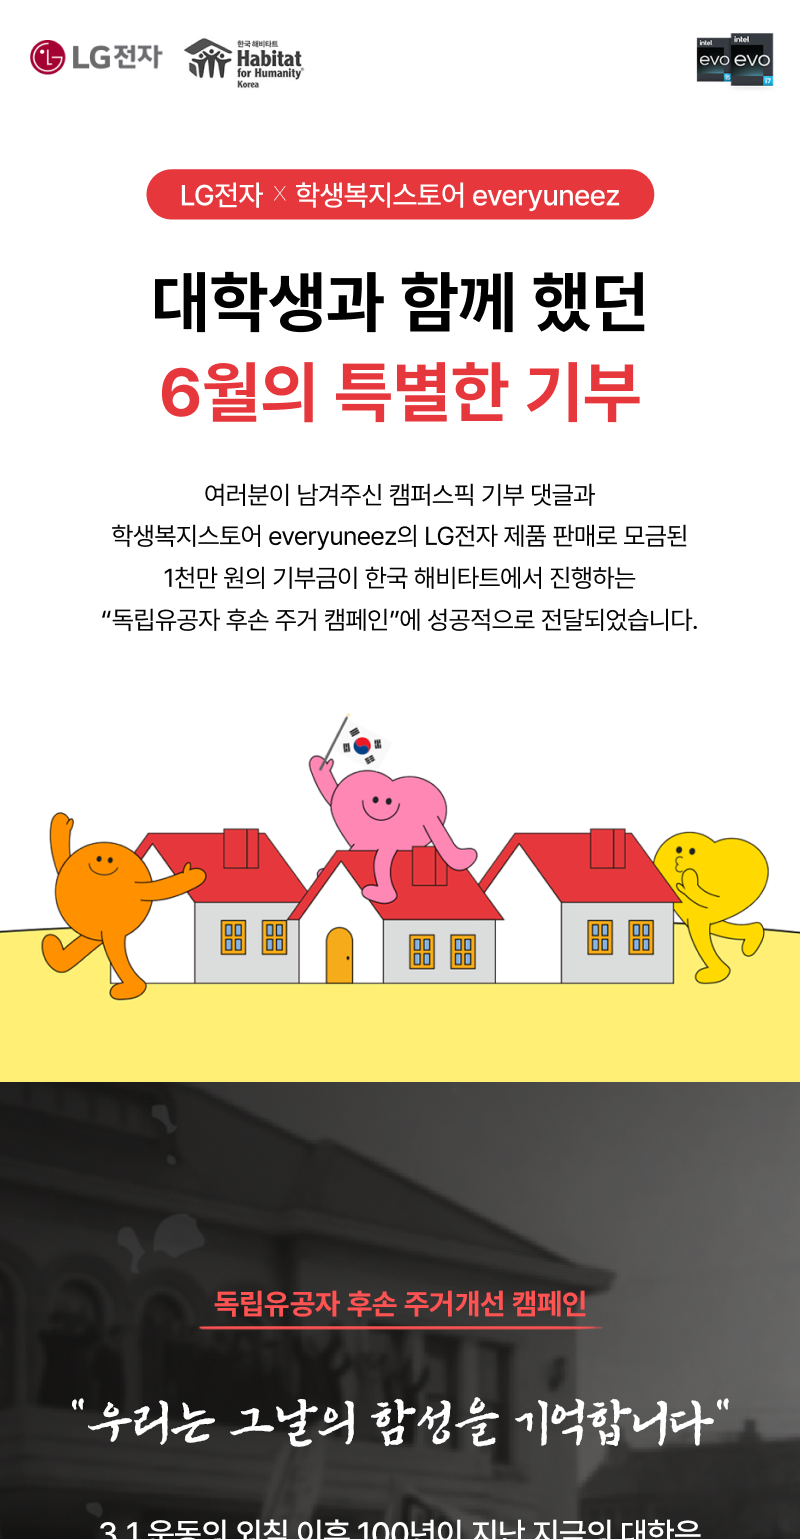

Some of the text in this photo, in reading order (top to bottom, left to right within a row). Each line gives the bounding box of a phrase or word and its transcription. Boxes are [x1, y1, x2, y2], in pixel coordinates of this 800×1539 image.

[73, 45, 163, 69] LG전자
[237, 50, 302, 67] Habitat
[699, 55, 731, 66] evo
[734, 54, 771, 67] evo
[237, 68, 302, 80] for Humanity
[237, 81, 260, 89] Korea
[182, 182, 263, 208] LG전자
[296, 182, 463, 208] 학생복지스토어
[473, 190, 619, 211] everyuneez
[155, 272, 644, 332] 대학생과 함께 했던
[162, 362, 640, 422] 6월의 특별한 기부
[205, 483, 595, 506] 여러분이 남겨주신 캠퍼스픽 기부 댓글과
[226, 608, 269, 631] 후손
[275, 609, 316, 631] 주거
[428, 609, 535, 631] 성공적으로
[542, 609, 697, 631] 전달되었습니다.
[215, 1291, 585, 1317] 독립유공자 후손 주거개선 캠페인
[230, 1399, 354, 1447] 그날의
[371, 1397, 499, 1446] 함성을
